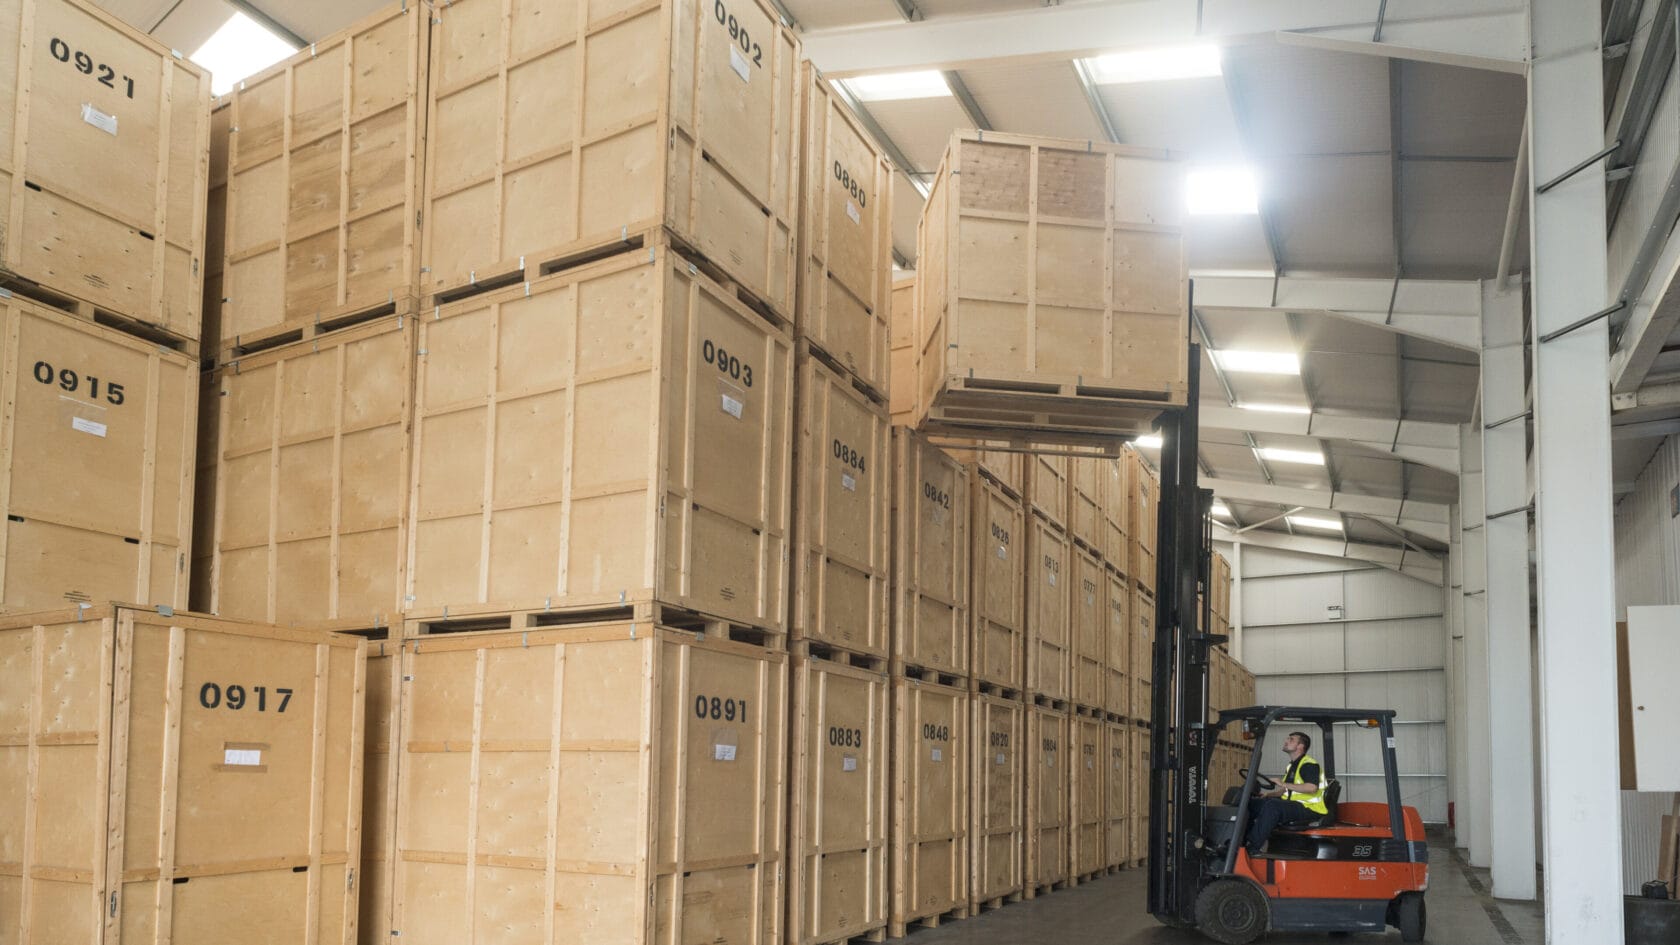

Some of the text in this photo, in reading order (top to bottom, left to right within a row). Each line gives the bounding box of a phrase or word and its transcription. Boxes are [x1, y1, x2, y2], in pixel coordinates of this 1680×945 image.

[715, 0, 762, 68] 0902
[50, 38, 134, 99] 0921
[834, 161, 866, 208] 0880
[702, 339, 753, 388] 0903
[33, 361, 125, 406] 0915
[833, 438, 866, 475] 0884
[924, 481, 950, 511] 0842
[199, 682, 293, 713] 0917
[694, 694, 746, 724] 0891
[828, 726, 862, 749] 0883
[923, 723, 949, 742] 0848
[1188, 765, 1197, 804] TOYOTA
[1352, 845, 1373, 858] 35
[1358, 866, 1377, 876] SAS
